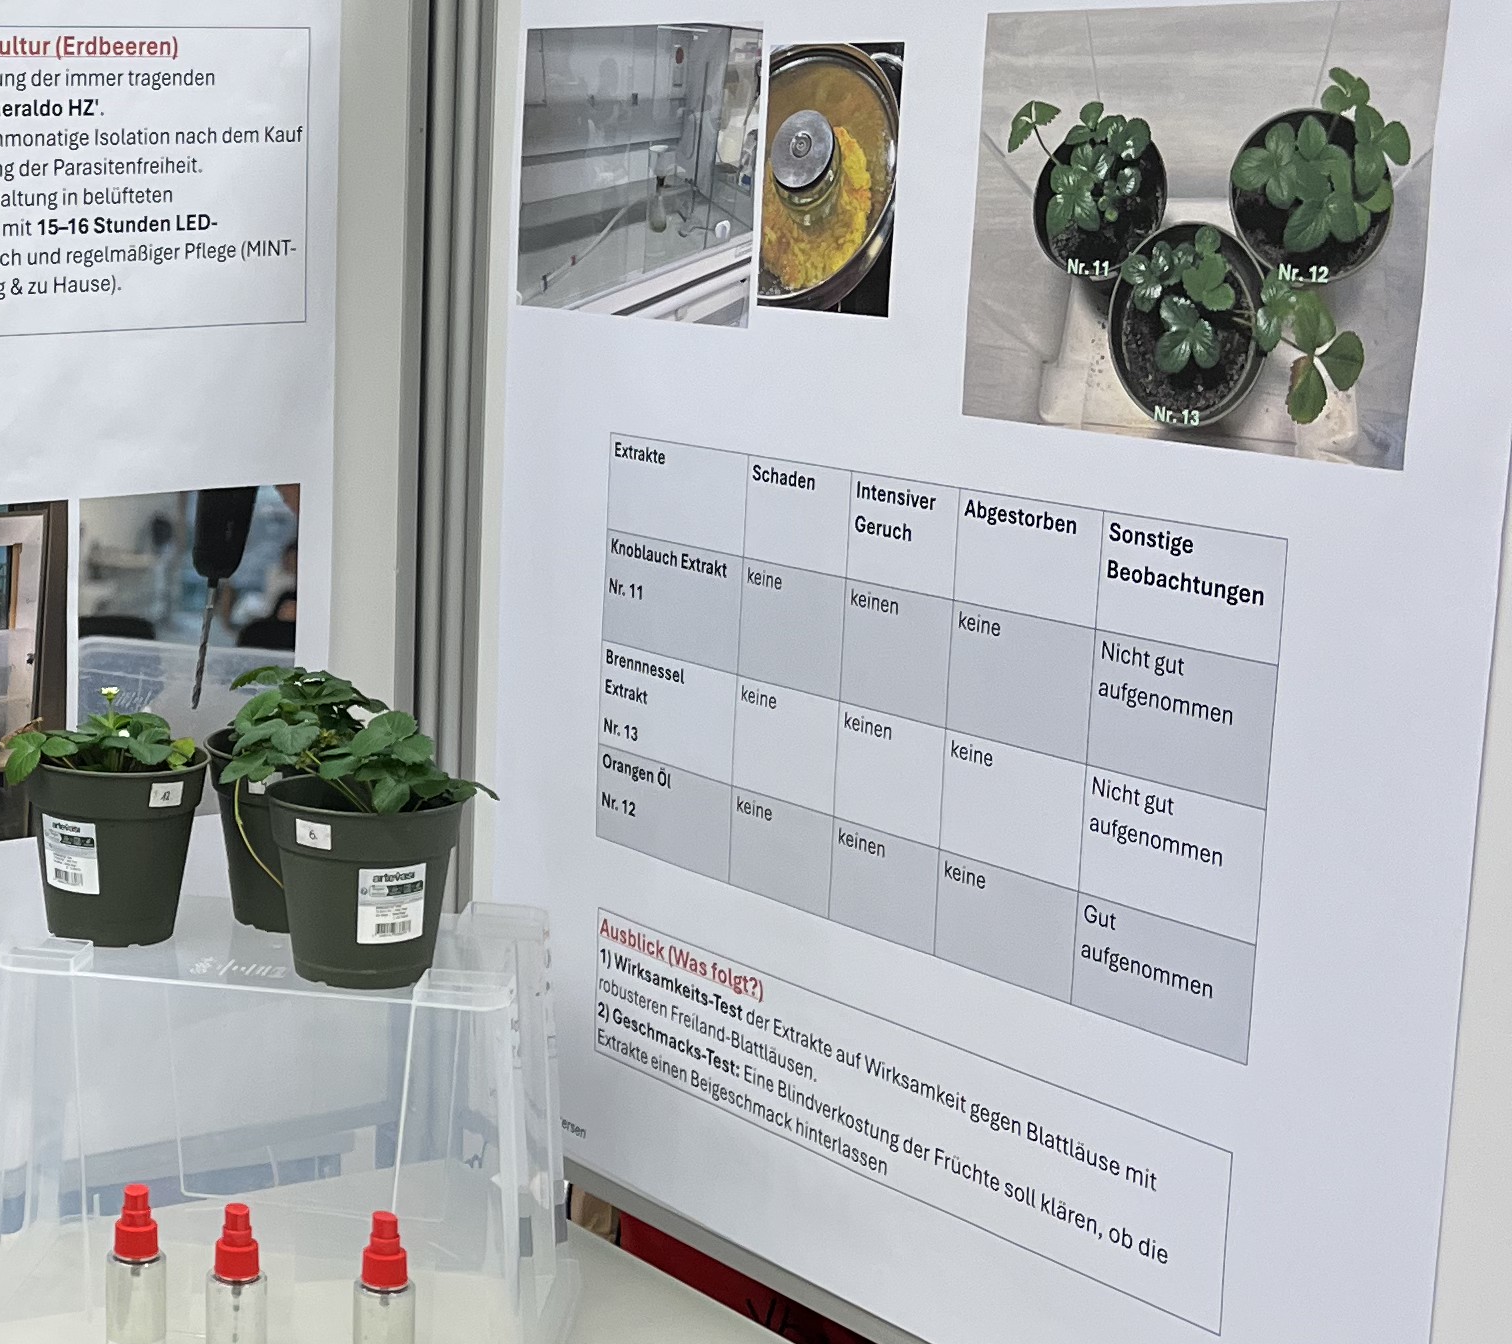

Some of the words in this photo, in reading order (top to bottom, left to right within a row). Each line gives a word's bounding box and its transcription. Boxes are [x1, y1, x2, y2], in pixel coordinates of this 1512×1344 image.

[55, 35, 179, 55] (Erdbeeren)
[61, 187, 79, 207] in
[83, 185, 173, 206] belüfteten
[1066, 257, 1090, 276] Nr.
[1091, 259, 1111, 277] 11
[1278, 262, 1305, 283] Nr.
[1307, 264, 1330, 284] 12
[1153, 404, 1178, 424] Nr.
[1181, 408, 1201, 427] 13
[613, 441, 666, 465] Extrakte
[751, 463, 816, 491] Schaden
[856, 480, 937, 511] Intensiver
[854, 515, 913, 543] Geruch
[963, 498, 1077, 535] Abgestorben
[1108, 521, 1194, 557] Sonstige
[607, 533, 679, 568] Knoblauch
[680, 552, 728, 579] Extrakt
[608, 577, 627, 597] Nr.
[629, 583, 643, 601] 11
[746, 566, 783, 591] keine
[1106, 559, 1265, 607] Beobachtungen
[850, 587, 899, 616] keinen
[957, 610, 1001, 637] keine
[605, 647, 685, 685] Brennnessel
[1101, 639, 1151, 670] Nicht
[1153, 655, 1185, 677] gut
[604, 677, 649, 705] Extrakt
[740, 684, 777, 710] keine
[1097, 681, 1233, 727] aufgenommen
[603, 716, 621, 737] Nr.
[623, 724, 639, 743] 13
[843, 711, 893, 741] keinen
[950, 739, 993, 767] keine
[601, 753, 655, 785] Orangen
[657, 766, 672, 790] Öl
[599, 791, 619, 812] Nr.
[621, 799, 637, 818] 12
[735, 795, 773, 822] keine
[1091, 775, 1141, 807] Nicht
[1143, 793, 1175, 817] gut
[837, 826, 886, 859] keinen
[1089, 817, 1223, 867] aufgenommen
[943, 859, 987, 890] keine
[1083, 903, 1117, 931] Gut
[597, 915, 665, 961] Ausblick
[667, 944, 708, 977] (Was
[710, 961, 764, 998] folgt?)
[1080, 943, 1213, 999] aufgenommen
[599, 947, 612, 970] 1)
[613, 951, 743, 1022] Wirksamkeits-Test
[745, 1008, 771, 1033] der
[773, 1017, 833, 1059] Extrakte
[835, 1047, 863, 1070] auf
[863, 1054, 967, 1115] Wirksamkeit
[969, 1103, 1022, 1137] gegen
[1026, 1121, 1121, 1177] Blattläuse
[1125, 1165, 1157, 1193] mit
